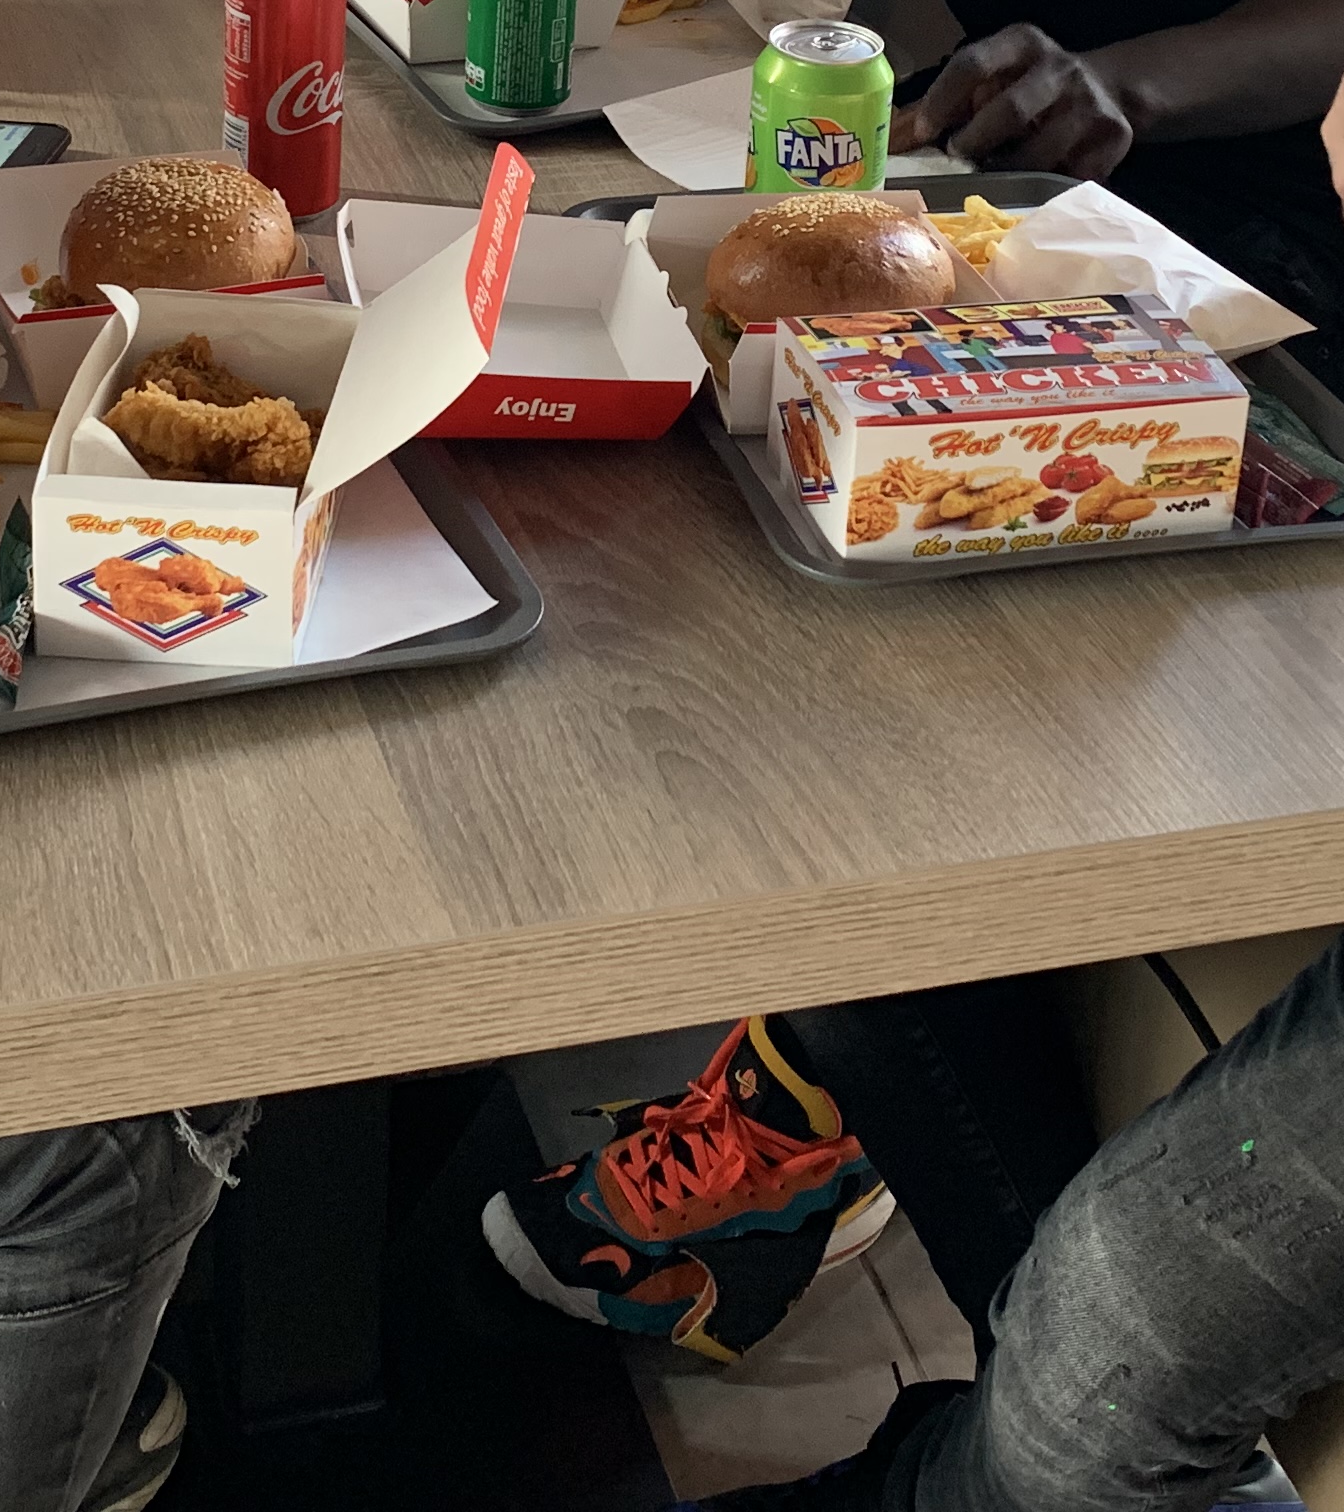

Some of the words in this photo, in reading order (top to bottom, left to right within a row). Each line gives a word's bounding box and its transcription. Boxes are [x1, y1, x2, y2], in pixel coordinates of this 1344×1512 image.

[777, 129, 863, 168] FANTA
[855, 360, 1220, 403] CHICKEN
[494, 396, 576, 422] Enjoy
[929, 429, 1005, 460] Hot
[1061, 419, 1180, 449] Crispy
[66, 513, 123, 533] Hot
[166, 519, 259, 546] Crispy
[913, 534, 952, 558] the
[955, 536, 1005, 555] way
[1009, 531, 1055, 553] you
[1057, 523, 1103, 545] like
